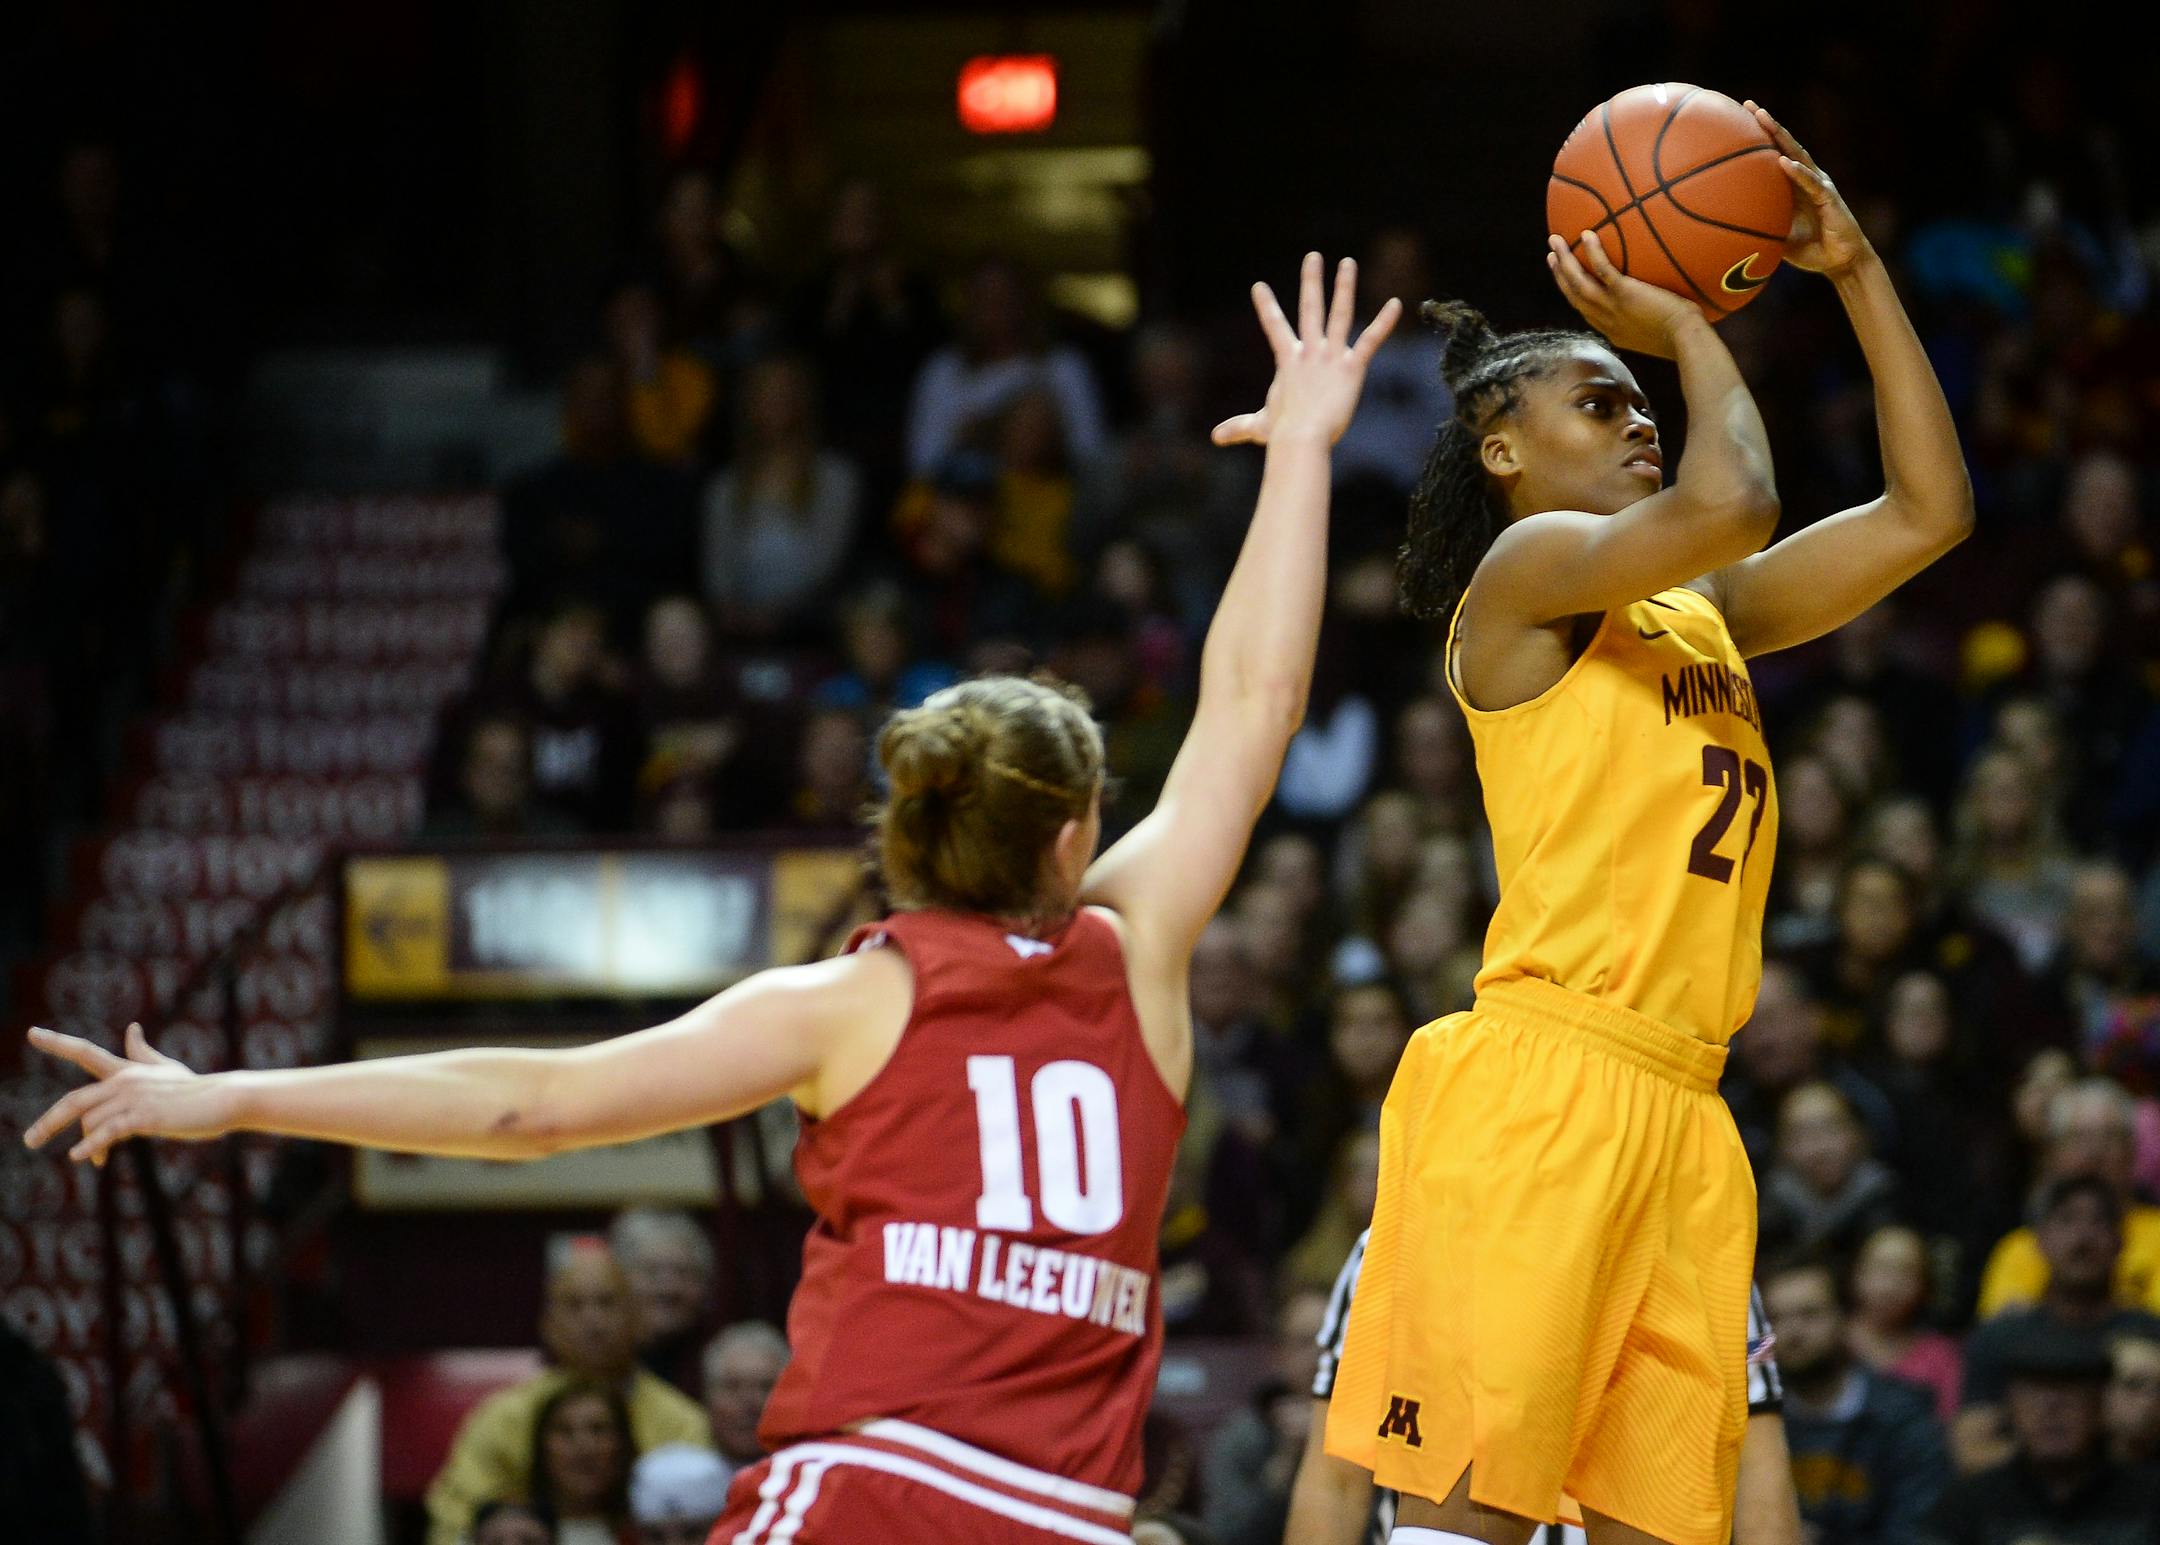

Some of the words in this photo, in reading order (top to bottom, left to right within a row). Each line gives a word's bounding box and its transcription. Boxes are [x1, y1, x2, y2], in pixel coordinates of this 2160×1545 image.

[967, 1055, 1123, 1235] 10
[883, 1222, 976, 1292] VAN
[1377, 1393, 1423, 1450] M
